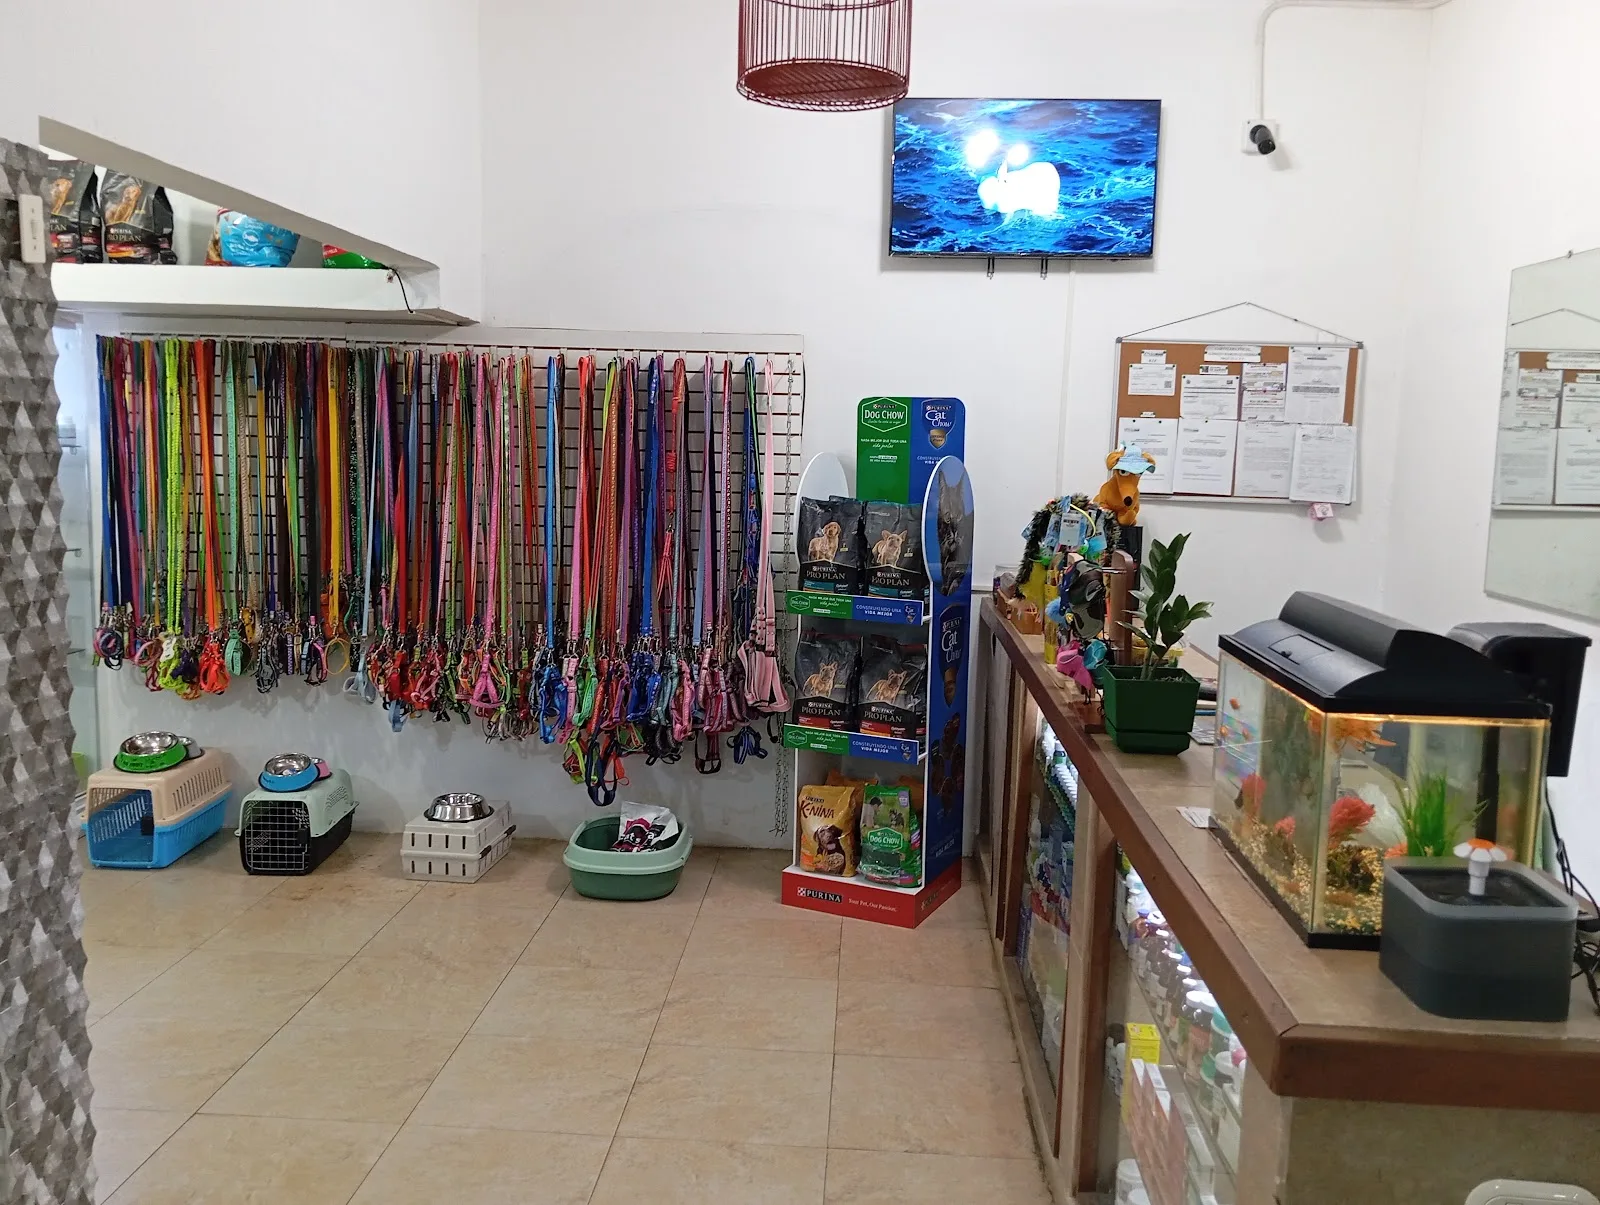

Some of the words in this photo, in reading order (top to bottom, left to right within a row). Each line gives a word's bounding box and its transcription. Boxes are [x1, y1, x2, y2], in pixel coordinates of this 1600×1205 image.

[864, 410, 880, 418] DOG
[882, 410, 904, 419] CHOW
[925, 410, 946, 421] Cat
[932, 419, 952, 427] Chow
[806, 571, 821, 579] PRO
[822, 572, 846, 580] PLAN
[887, 578, 910, 586] PLAN
[856, 604, 892, 612] CONSTRUYENDO
[941, 630, 958, 651] Cat
[801, 707, 817, 715] PRO
[818, 707, 841, 716] PLAN
[864, 711, 879, 719] PRO
[879, 712, 903, 722] PLAN
[852, 741, 887, 749] CONSTRUYENDO
[870, 835, 882, 843] DOG
[807, 889, 841, 902] PURINA
